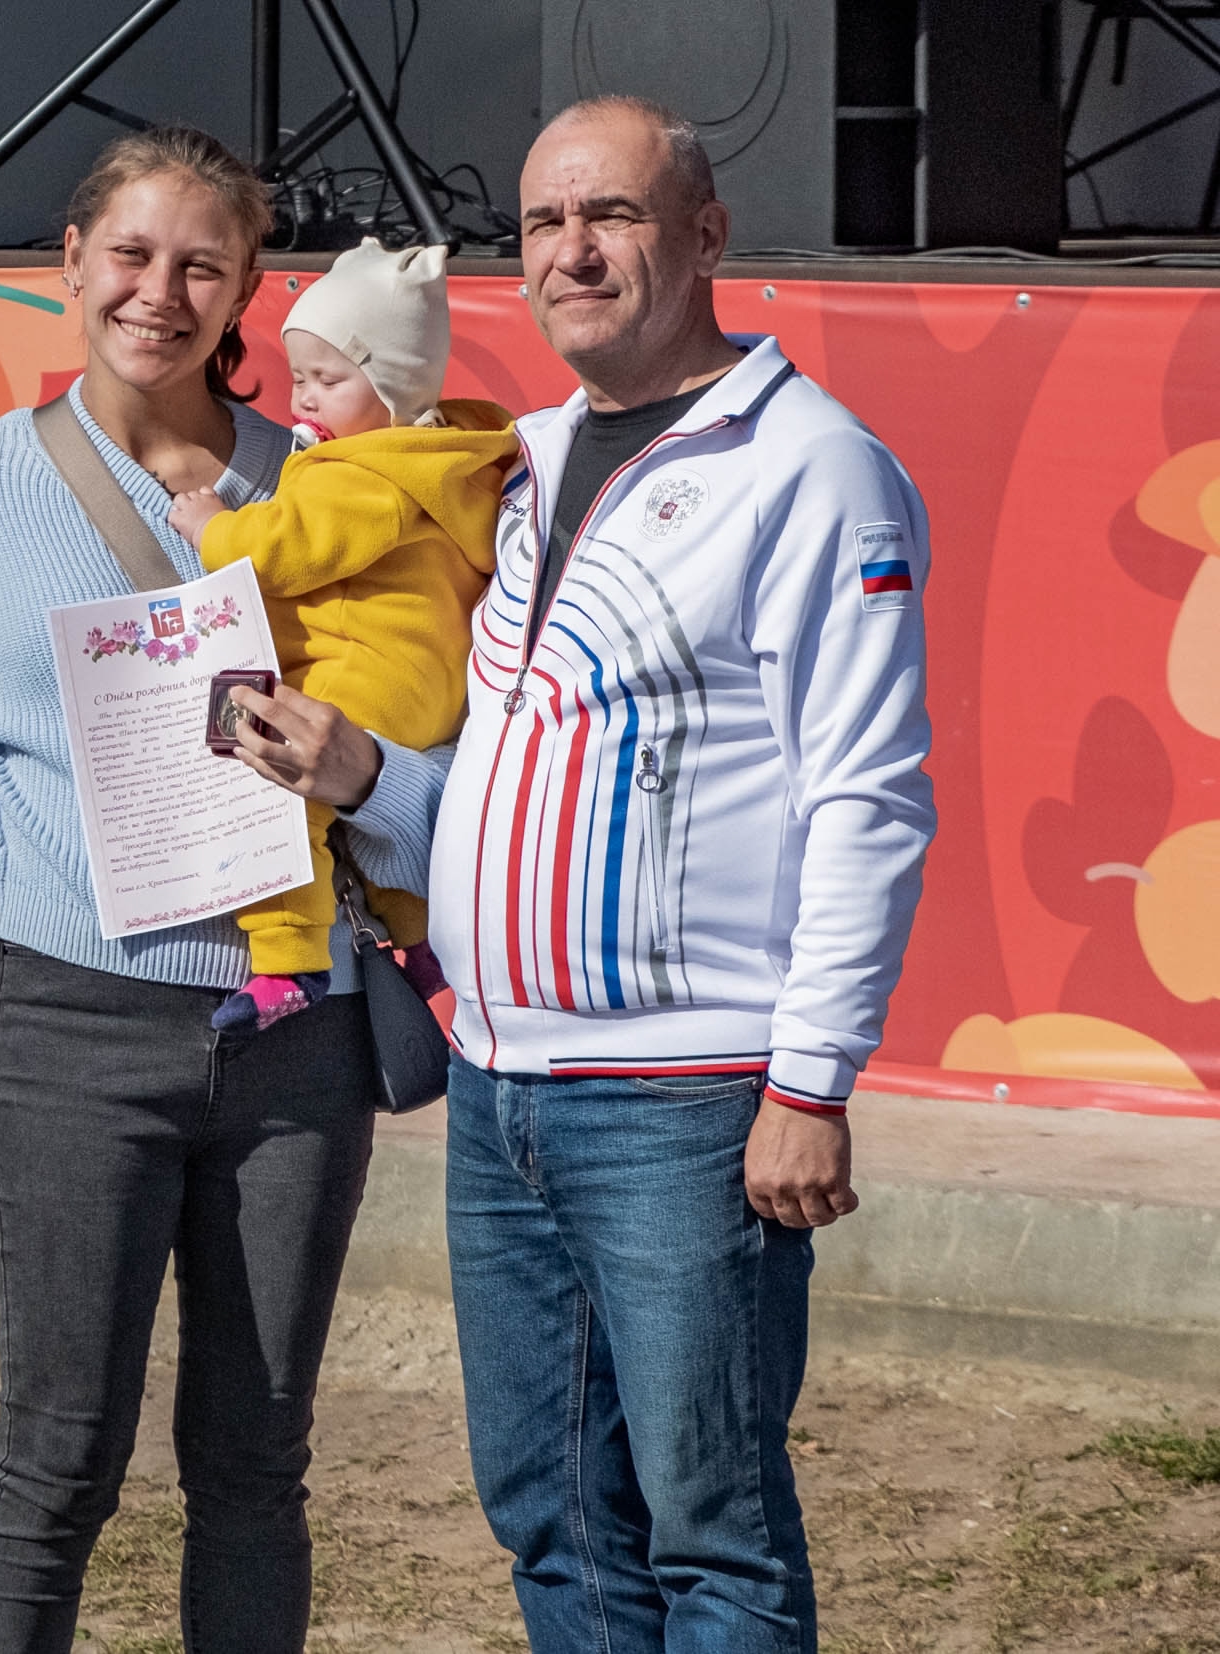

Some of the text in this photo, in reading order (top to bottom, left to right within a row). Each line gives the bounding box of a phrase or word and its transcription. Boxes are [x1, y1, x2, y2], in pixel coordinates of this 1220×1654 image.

[93, 694, 102, 706] С
[103, 692, 134, 704] Днём
[135, 682, 187, 701] рождения,
